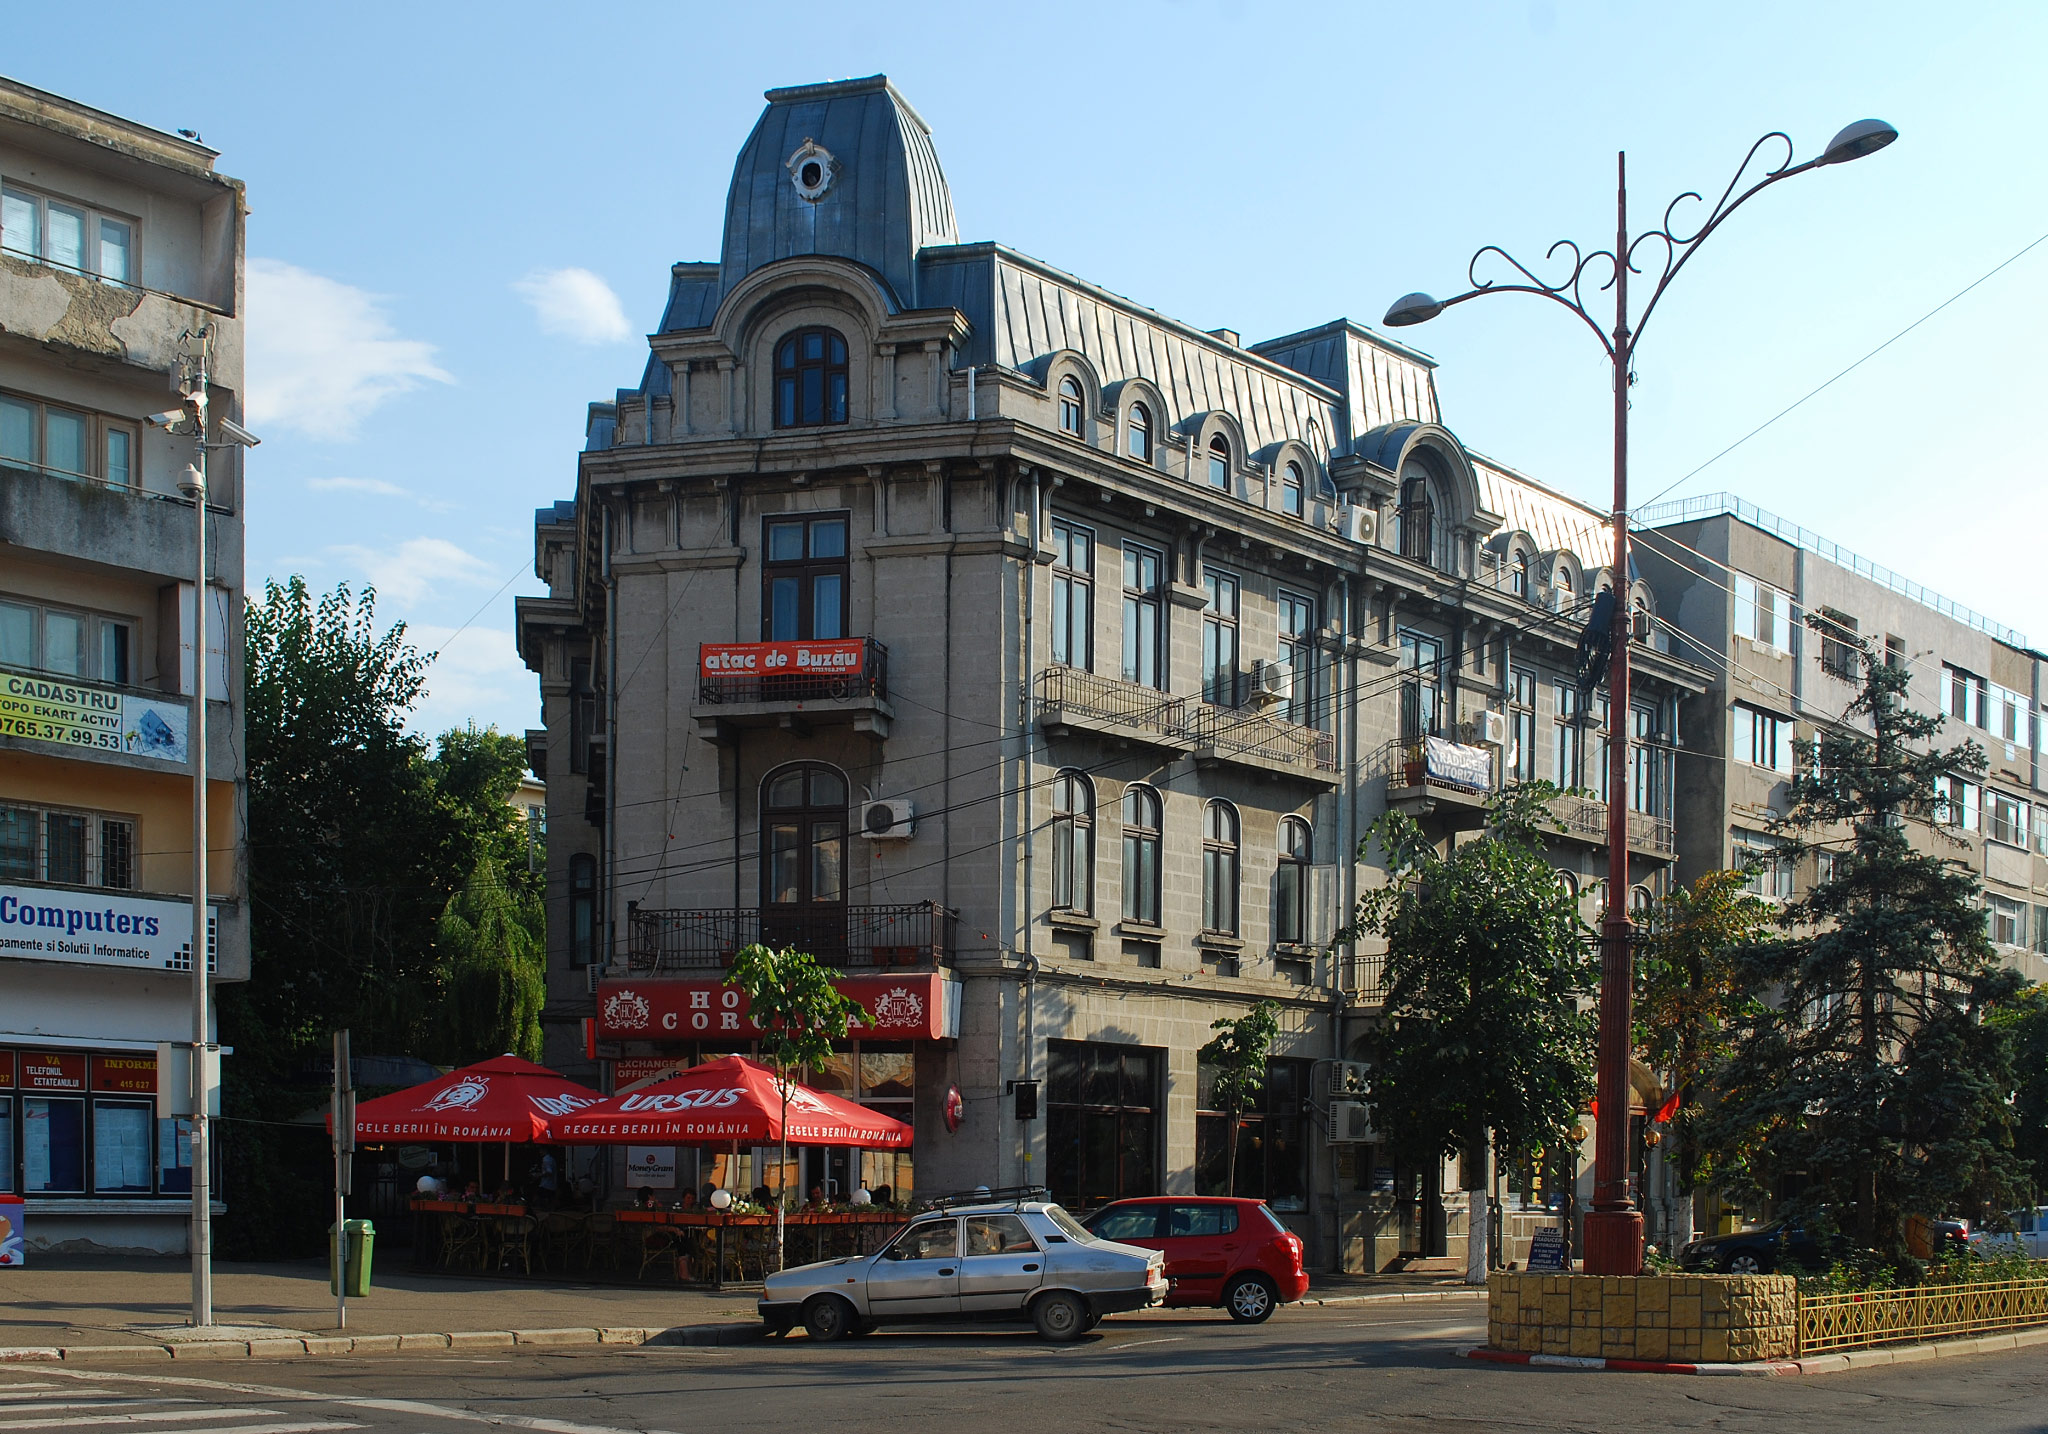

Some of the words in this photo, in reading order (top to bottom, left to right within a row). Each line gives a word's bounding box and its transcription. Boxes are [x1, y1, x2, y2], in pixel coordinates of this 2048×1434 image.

[705, 652, 756, 669] atac
[765, 649, 788, 667] de
[796, 649, 857, 667] Buzău
[8, 679, 118, 710] CADASTRU
[0, 699, 30, 713] OPO
[33, 705, 77, 721] EKART
[80, 713, 119, 728] ACTIV
[0, 717, 119, 749] 765.37.99.53
[1435, 751, 1488, 772] TRADUCERI
[1432, 763, 1488, 786] AUTORIZATE
[0, 895, 160, 936] Computers
[46, 940, 56, 952] si
[57, 941, 90, 955] Solutii
[93, 944, 150, 960] Informatice
[621, 1004, 633, 1018] HC
[662, 1012, 864, 1030] CORA
[46, 1056, 61, 1065] VA
[618, 1060, 677, 1068] EXCHANGE
[26, 1066, 63, 1076] TELEFONUL
[617, 1070, 656, 1078] OFFICE
[120, 1080, 134, 1088] 415
[135, 1081, 150, 1089] 627
[619, 1088, 749, 1113] URSUS
[357, 1123, 389, 1133] GELE
[394, 1124, 429, 1134] BERII
[434, 1122, 448, 1135] ÎN
[452, 1125, 512, 1137] ROMÂNIA
[563, 1124, 617, 1134] REGELE
[622, 1124, 661, 1134] BERII
[665, 1121, 681, 1134] ÎN
[686, 1121, 749, 1134] ROMÂNIA
[821, 1127, 848, 1138] BERII
[848, 1127, 859, 1139] ÎN
[860, 1129, 902, 1142] ROMÂNIA
[628, 1164, 674, 1173] MoneyGram
